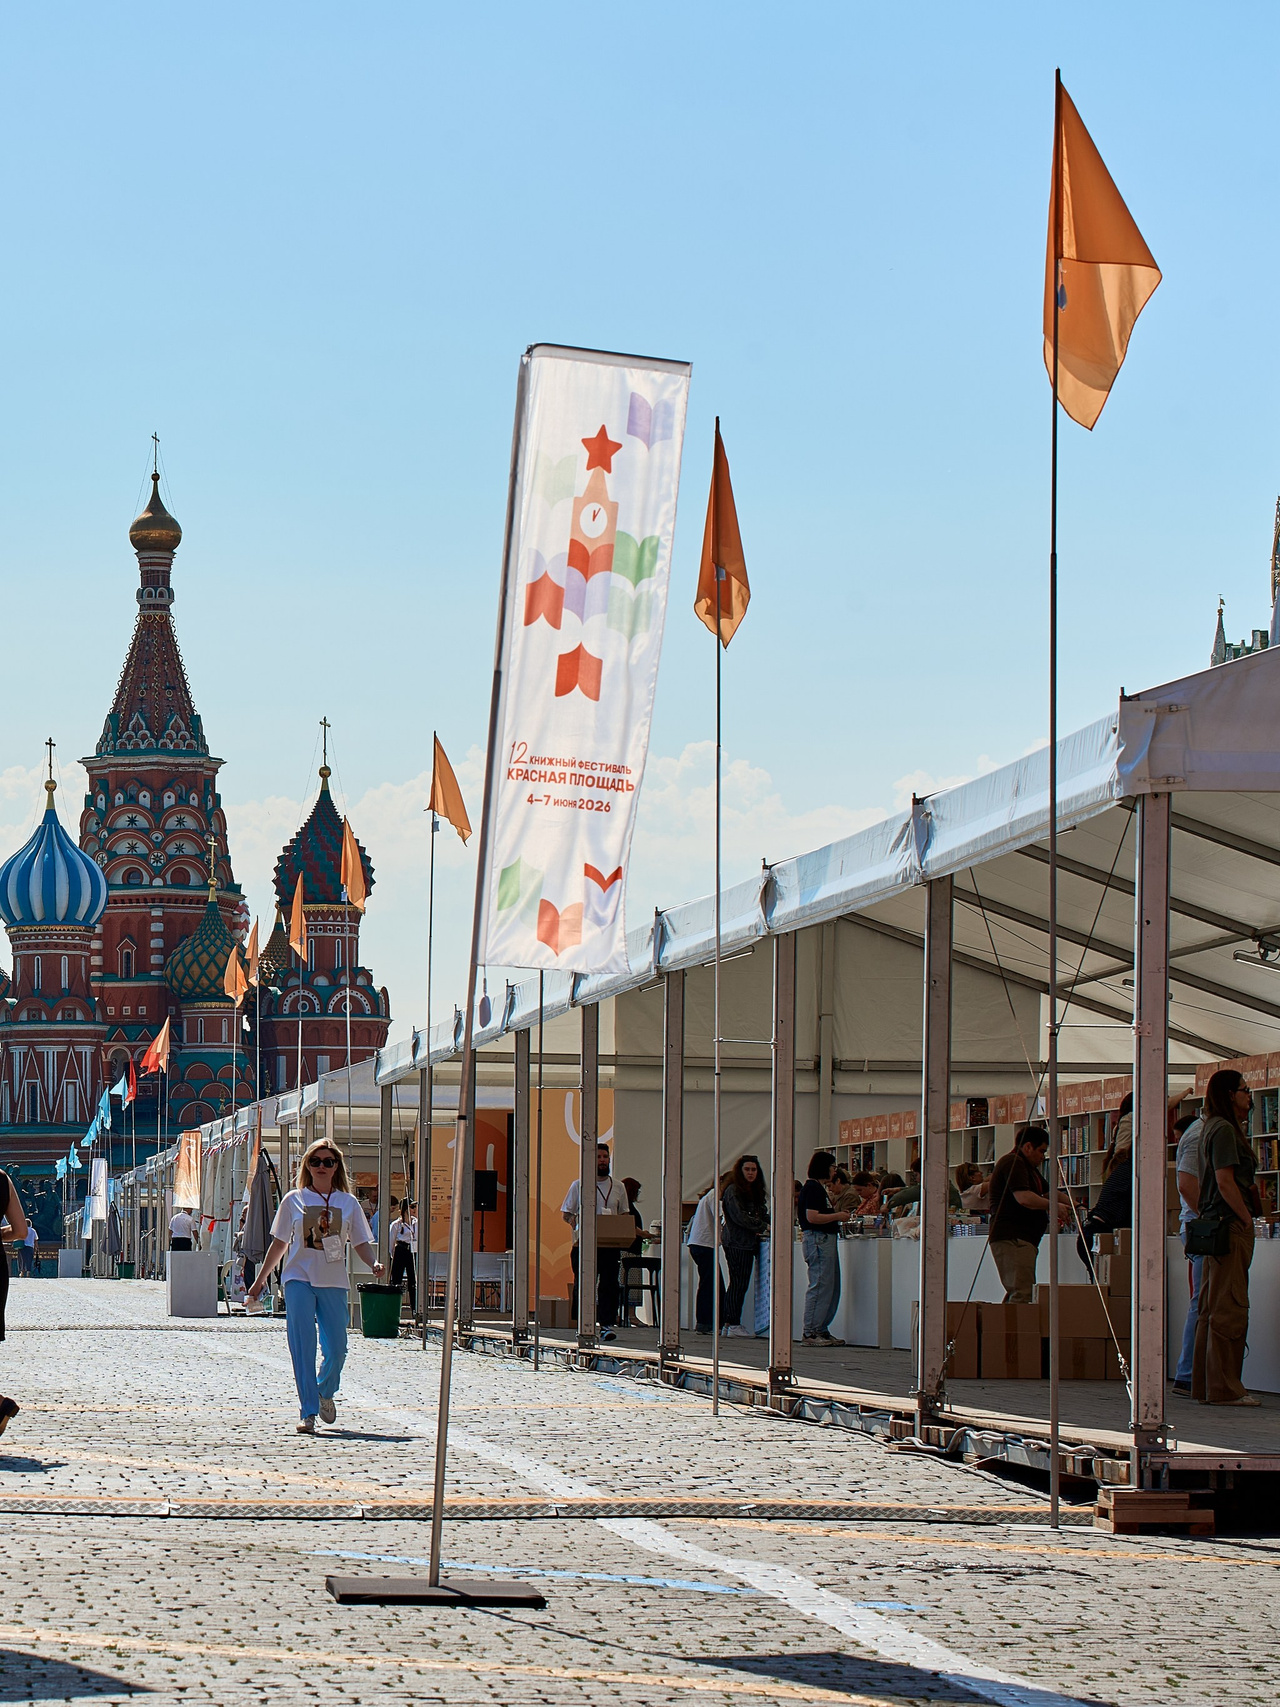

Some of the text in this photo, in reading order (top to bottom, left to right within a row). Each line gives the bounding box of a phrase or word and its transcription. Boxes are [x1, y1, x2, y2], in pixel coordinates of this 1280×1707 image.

[510, 741, 632, 775] 12 КНИЖНЫЙ ФЕСТИВАЛЬ
[507, 768, 635, 792] КРАСНАЯ ПЛОЩАДЬ
[578, 798, 611, 812] 2026
